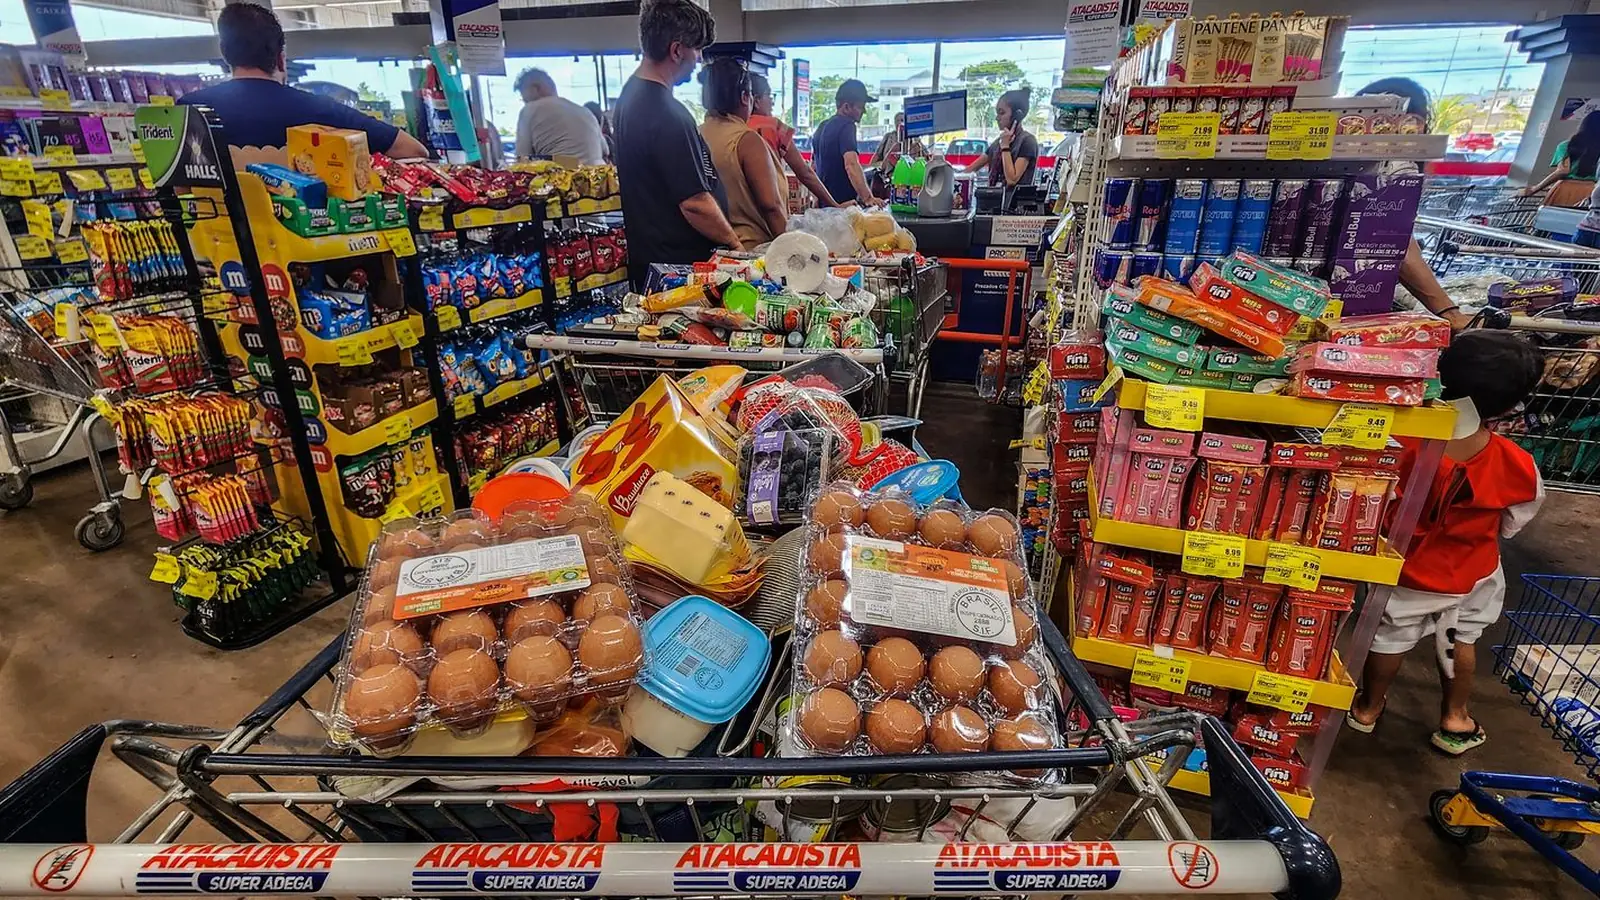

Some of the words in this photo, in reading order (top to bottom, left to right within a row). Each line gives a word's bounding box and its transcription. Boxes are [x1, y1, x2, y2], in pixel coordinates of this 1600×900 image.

[1071, 2, 1119, 16] ATACADISTA
[1143, 1, 1189, 12] ATACADISTA
[458, 24, 500, 32] ATACADISTA
[1194, 21, 1257, 36] PANTENE
[1260, 17, 1326, 32] PANTENE
[43, 135, 59, 145] 70
[141, 126, 174, 140] Trident
[1142, 206, 1160, 215] Red
[1365, 199, 1406, 212] AÇAÍ
[1349, 212, 1362, 232] Bull
[1306, 226, 1318, 244] Bull
[1344, 230, 1357, 250] Red
[1303, 242, 1314, 258] Red
[1233, 266, 1257, 282] fini
[1208, 283, 1232, 299] fini
[1344, 281, 1383, 294] AÇAÍ
[1112, 299, 1133, 314] fini
[1118, 327, 1139, 342] fini
[124, 355, 163, 366] Trident
[1066, 353, 1088, 364] fini
[1124, 352, 1141, 364] fini
[1215, 352, 1239, 365] fini
[1081, 386, 1096, 398] fin
[1137, 433, 1153, 443] fini
[1204, 439, 1223, 448] fini
[1068, 447, 1089, 457] fini
[1277, 449, 1294, 459] fini
[1145, 459, 1164, 470] fini
[1214, 474, 1233, 484] fini
[960, 594, 999, 614] BRASIL
[1189, 592, 1205, 602] fini
[1252, 602, 1269, 611] fini
[1297, 616, 1315, 626] fini
[972, 624, 995, 635] S.I.F.
[1190, 684, 1213, 697] fini
[1253, 725, 1279, 741] fini
[1264, 766, 1290, 781] fini
[568, 775, 637, 791] tilizável.
[141, 844, 343, 869] ATACADISTA
[415, 843, 607, 868] ATACADISTA
[675, 843, 862, 868] ATACADISTA
[934, 842, 1120, 868] ATACADISTA
[209, 876, 259, 891] SUPER
[262, 876, 314, 890] ADEGA
[483, 875, 533, 889] SUPER
[535, 875, 586, 889] ADEGA
[745, 875, 795, 889] SUPER
[796, 875, 847, 889] ADEGA
[1005, 874, 1056, 889] SUPER
[1056, 874, 1108, 889] ADEGA
